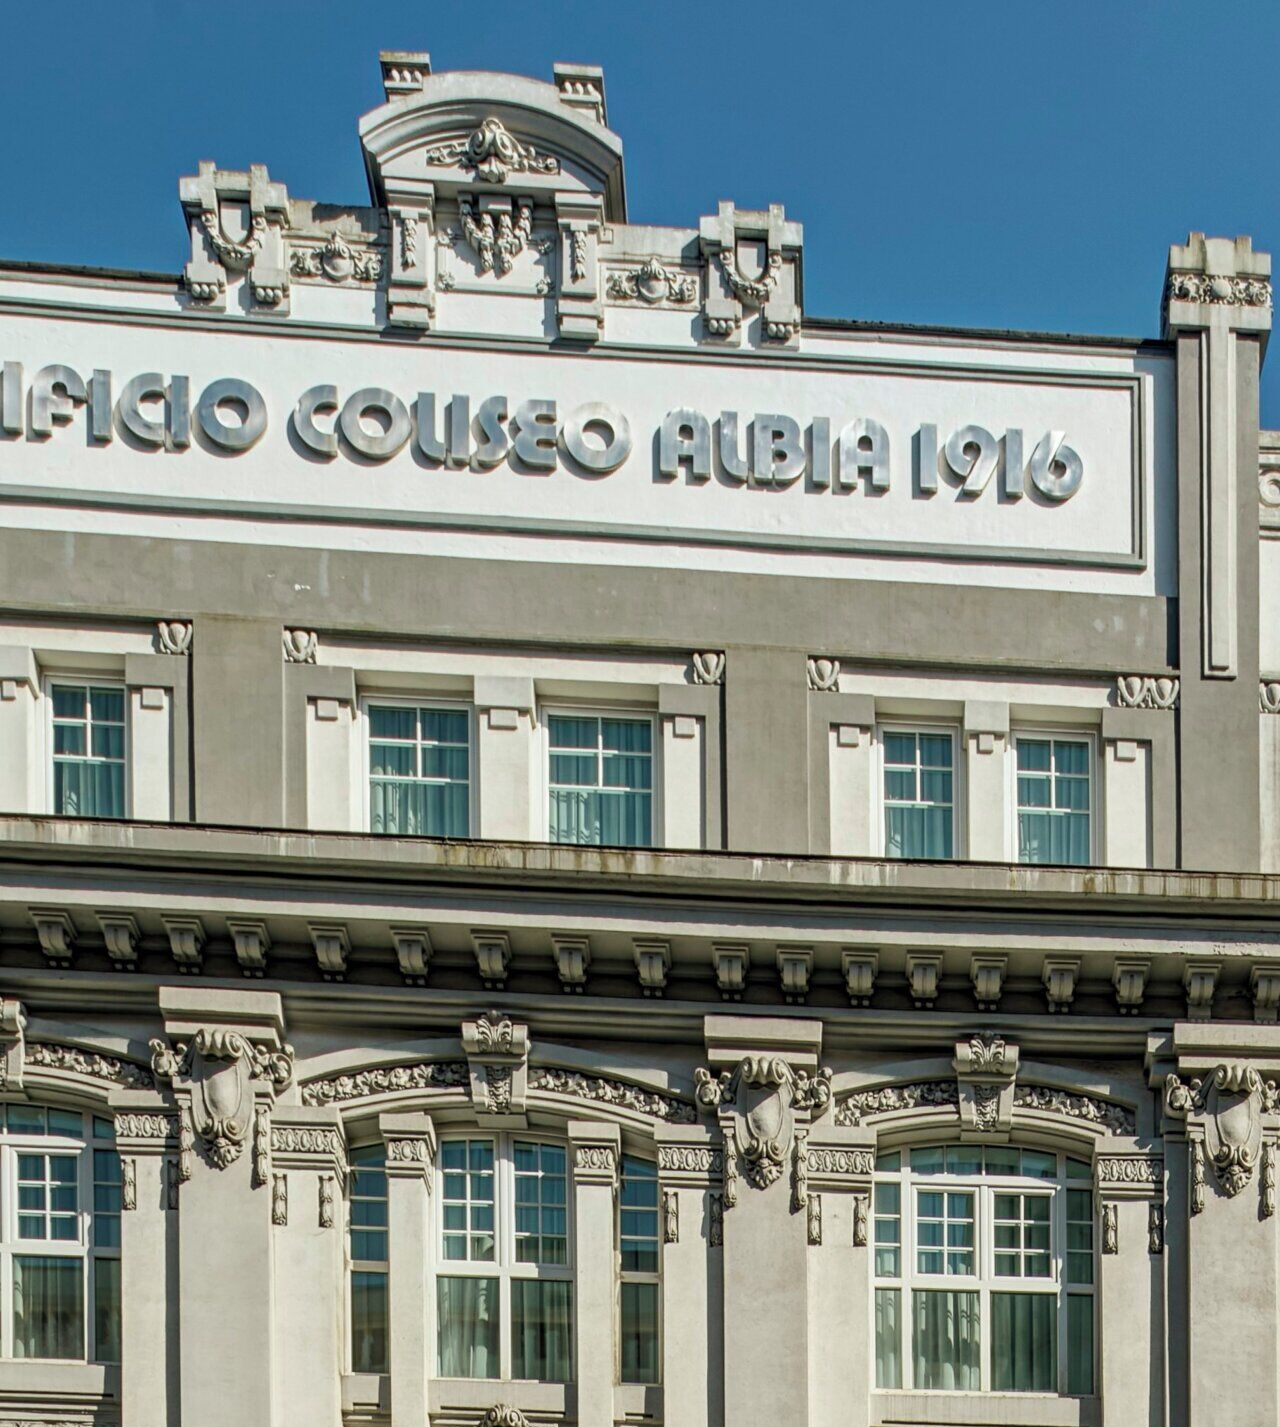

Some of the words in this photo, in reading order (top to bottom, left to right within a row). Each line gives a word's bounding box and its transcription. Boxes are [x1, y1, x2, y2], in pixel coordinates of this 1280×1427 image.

[291, 384, 634, 474] COLISEO
[657, 407, 891, 495] ALBIA
[917, 423, 1084, 502] 1916
